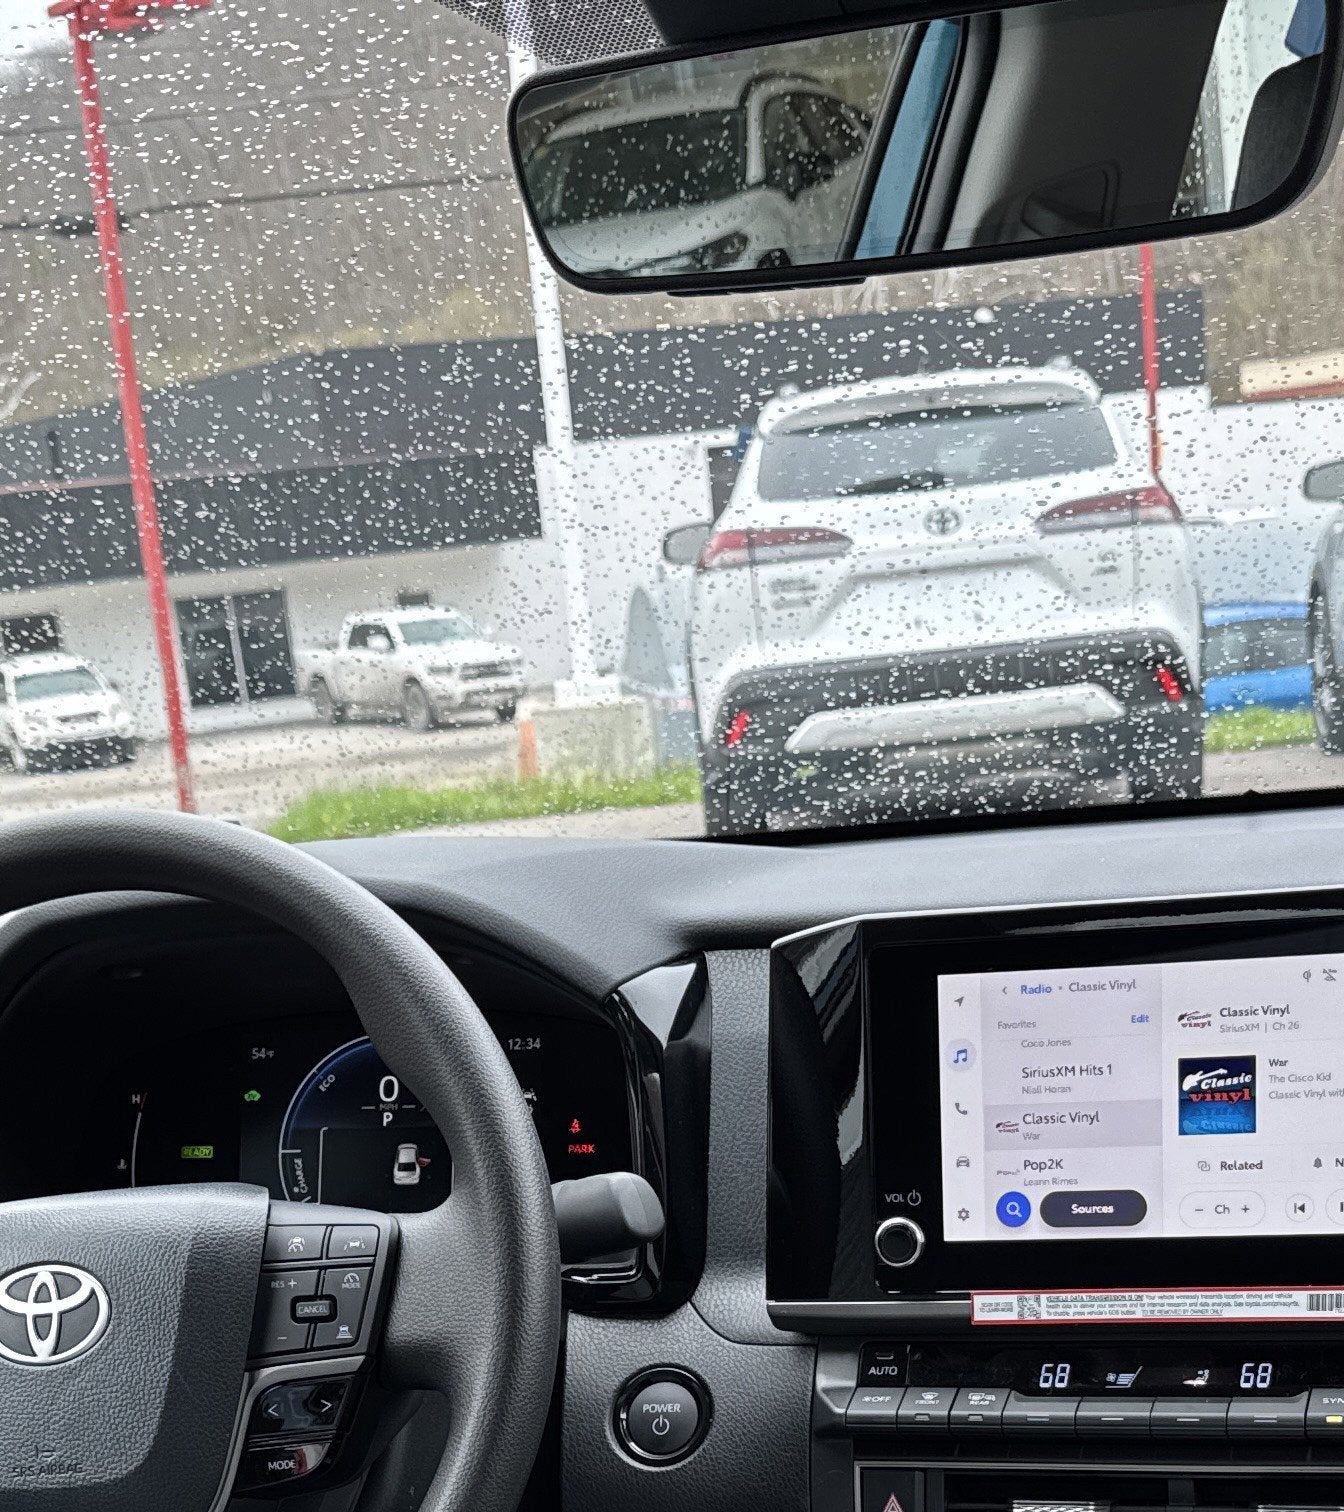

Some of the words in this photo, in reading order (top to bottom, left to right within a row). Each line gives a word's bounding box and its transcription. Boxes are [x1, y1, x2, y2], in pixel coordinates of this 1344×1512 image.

[1020, 985, 1052, 994] Radio
[1068, 982, 1106, 992] Classic
[1108, 979, 1136, 991] Vinyl
[1219, 1006, 1259, 1018] Classic
[1260, 1004, 1290, 1017] Vinyl
[1131, 1014, 1150, 1023] Edit
[997, 1021, 1036, 1030] Favorites
[1219, 1022, 1260, 1033] SiriusXM
[1272, 1022, 1286, 1031] Ch
[1288, 1021, 1300, 1030] 26
[507, 1037, 541, 1051] 12:34
[1045, 1038, 1072, 1048] Jones
[1268, 1059, 1288, 1067] War
[1021, 1065, 1076, 1079] SiriusXM
[1079, 1064, 1104, 1076] Hits
[1106, 1064, 1112, 1075] 1
[318, 1074, 336, 1092] ECO
[1200, 1073, 1252, 1090] Classic
[1269, 1074, 1286, 1083] The
[1288, 1073, 1314, 1082] Cisco
[1316, 1072, 1332, 1082] Kid
[379, 1075, 399, 1102] 0
[1044, 1085, 1072, 1093] Horan
[131, 1094, 141, 1104] H
[1189, 1088, 1251, 1104] vinyl
[1268, 1090, 1301, 1099] Classic
[1303, 1089, 1326, 1100] Vinyl
[382, 1112, 393, 1127] P
[1022, 1112, 1066, 1125] Classic
[1068, 1110, 1100, 1125] Vinyl
[1022, 1132, 1040, 1141] War
[567, 1144, 596, 1154] PARK
[1023, 1158, 1064, 1173] Pop2K
[1220, 1160, 1263, 1171] Related
[1051, 1177, 1078, 1186] Rimes
[885, 1193, 904, 1202] VOL
[1071, 1203, 1114, 1214] Sources
[1214, 1204, 1230, 1215] Ch
[298, 1305, 328, 1314] CANCEL
[868, 1366, 898, 1376] AUTO
[1039, 1363, 1071, 1388] 68
[1239, 1362, 1273, 1388] 68
[642, 1403, 681, 1413] POWER
[268, 1459, 296, 1471] MODE
